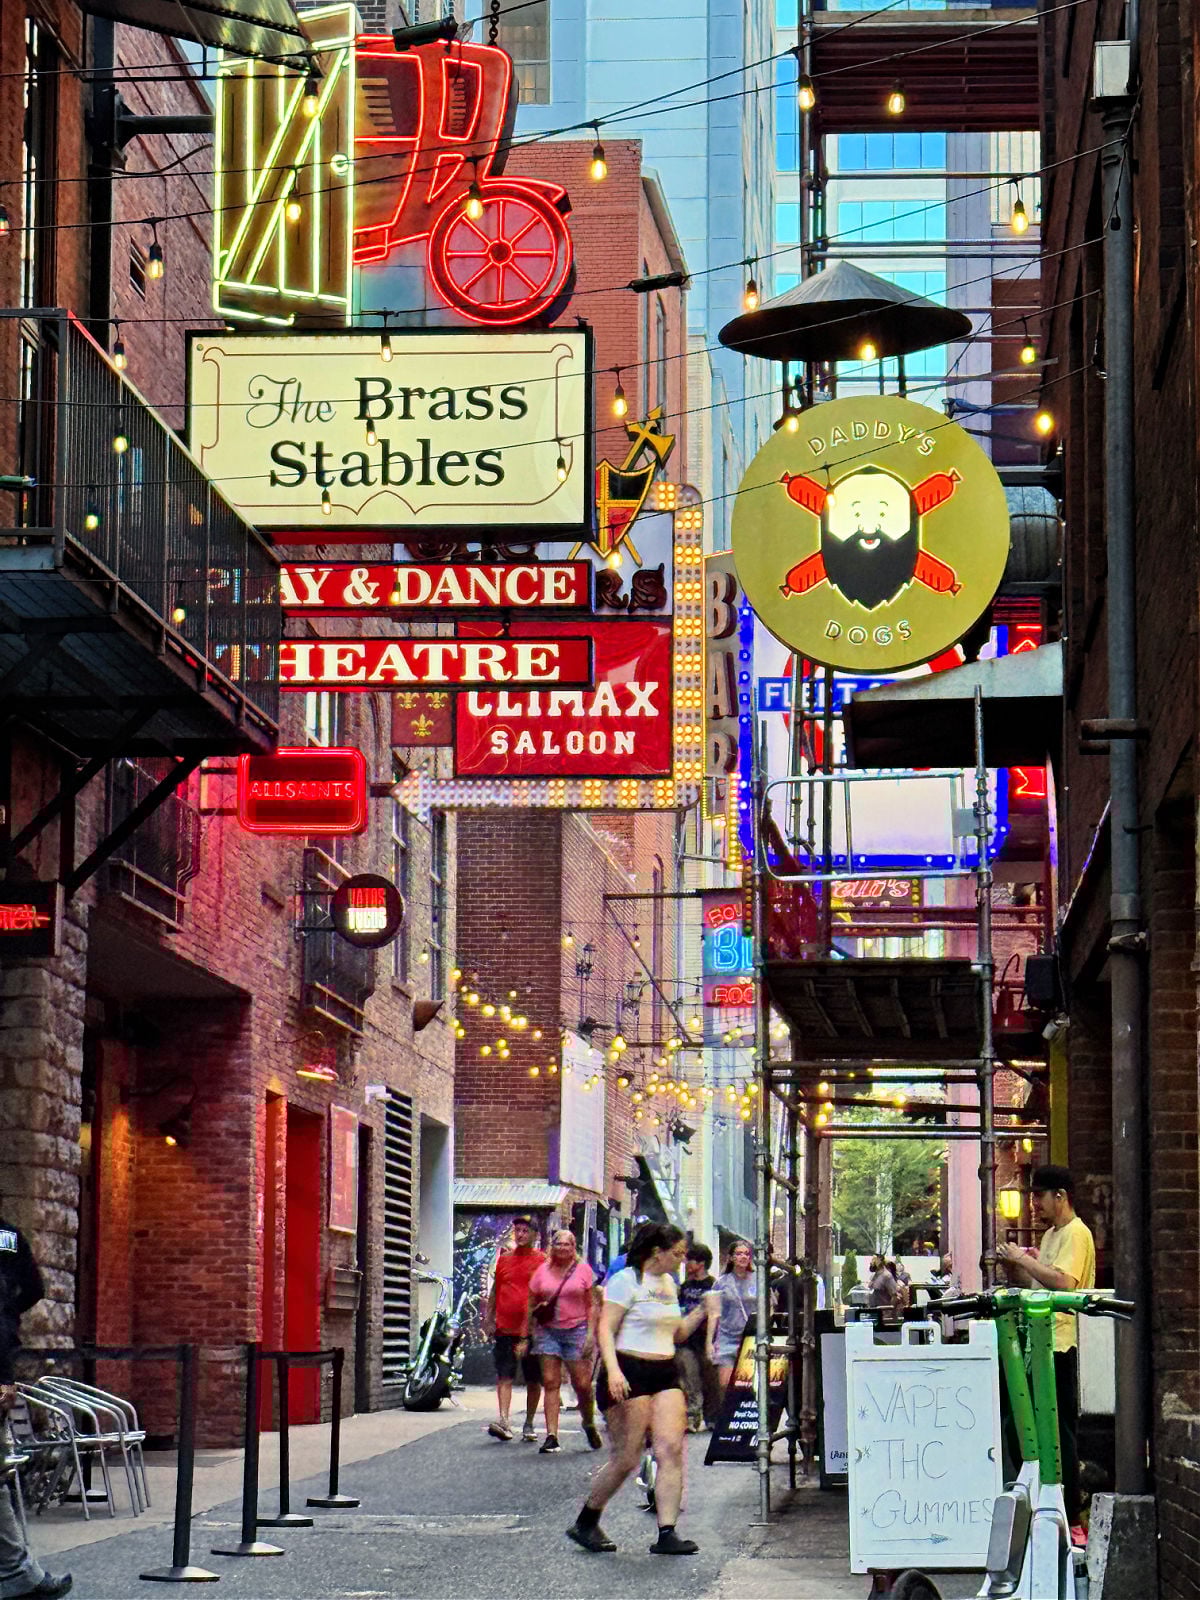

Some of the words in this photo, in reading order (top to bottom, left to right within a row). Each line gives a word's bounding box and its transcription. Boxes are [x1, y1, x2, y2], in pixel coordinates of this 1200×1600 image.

[246, 374, 337, 428] The
[354, 377, 528, 421] Brass
[807, 419, 937, 457] DADDY'S
[270, 438, 505, 488] Stables
[343, 567, 380, 606] &
[393, 566, 576, 606] DANCE
[824, 619, 912, 646] DOGS
[468, 681, 659, 717] CLIMAX
[491, 730, 636, 755] SALOON
[250, 782, 355, 798] ALLSAINTS
[865, 1382, 976, 1430] VAPES
[873, 1439, 949, 1480] THC
[871, 1489, 994, 1529] GUMMIES
